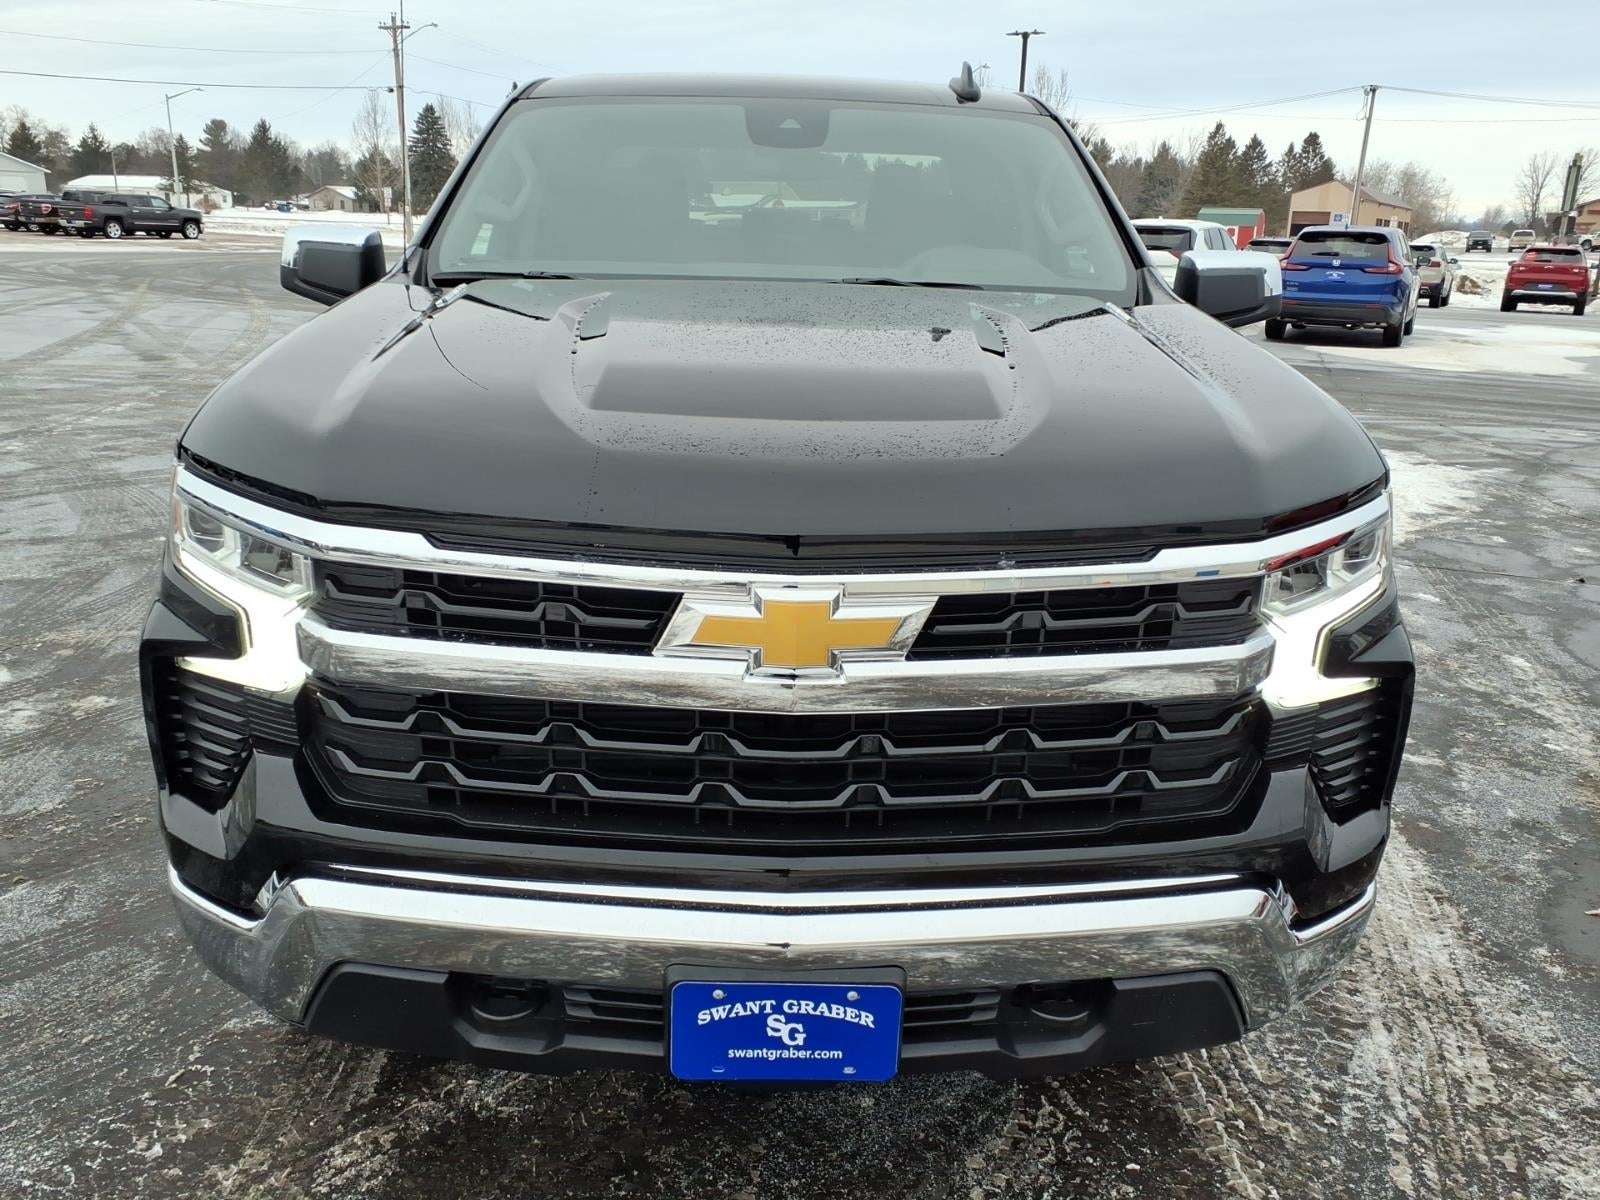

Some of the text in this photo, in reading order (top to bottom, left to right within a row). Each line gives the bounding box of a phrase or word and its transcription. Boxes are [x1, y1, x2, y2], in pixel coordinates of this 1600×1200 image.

[697, 999, 875, 1029] SWANT GRABER
[766, 1014, 807, 1046] SG
[727, 1047, 843, 1061] swantgraber.com
